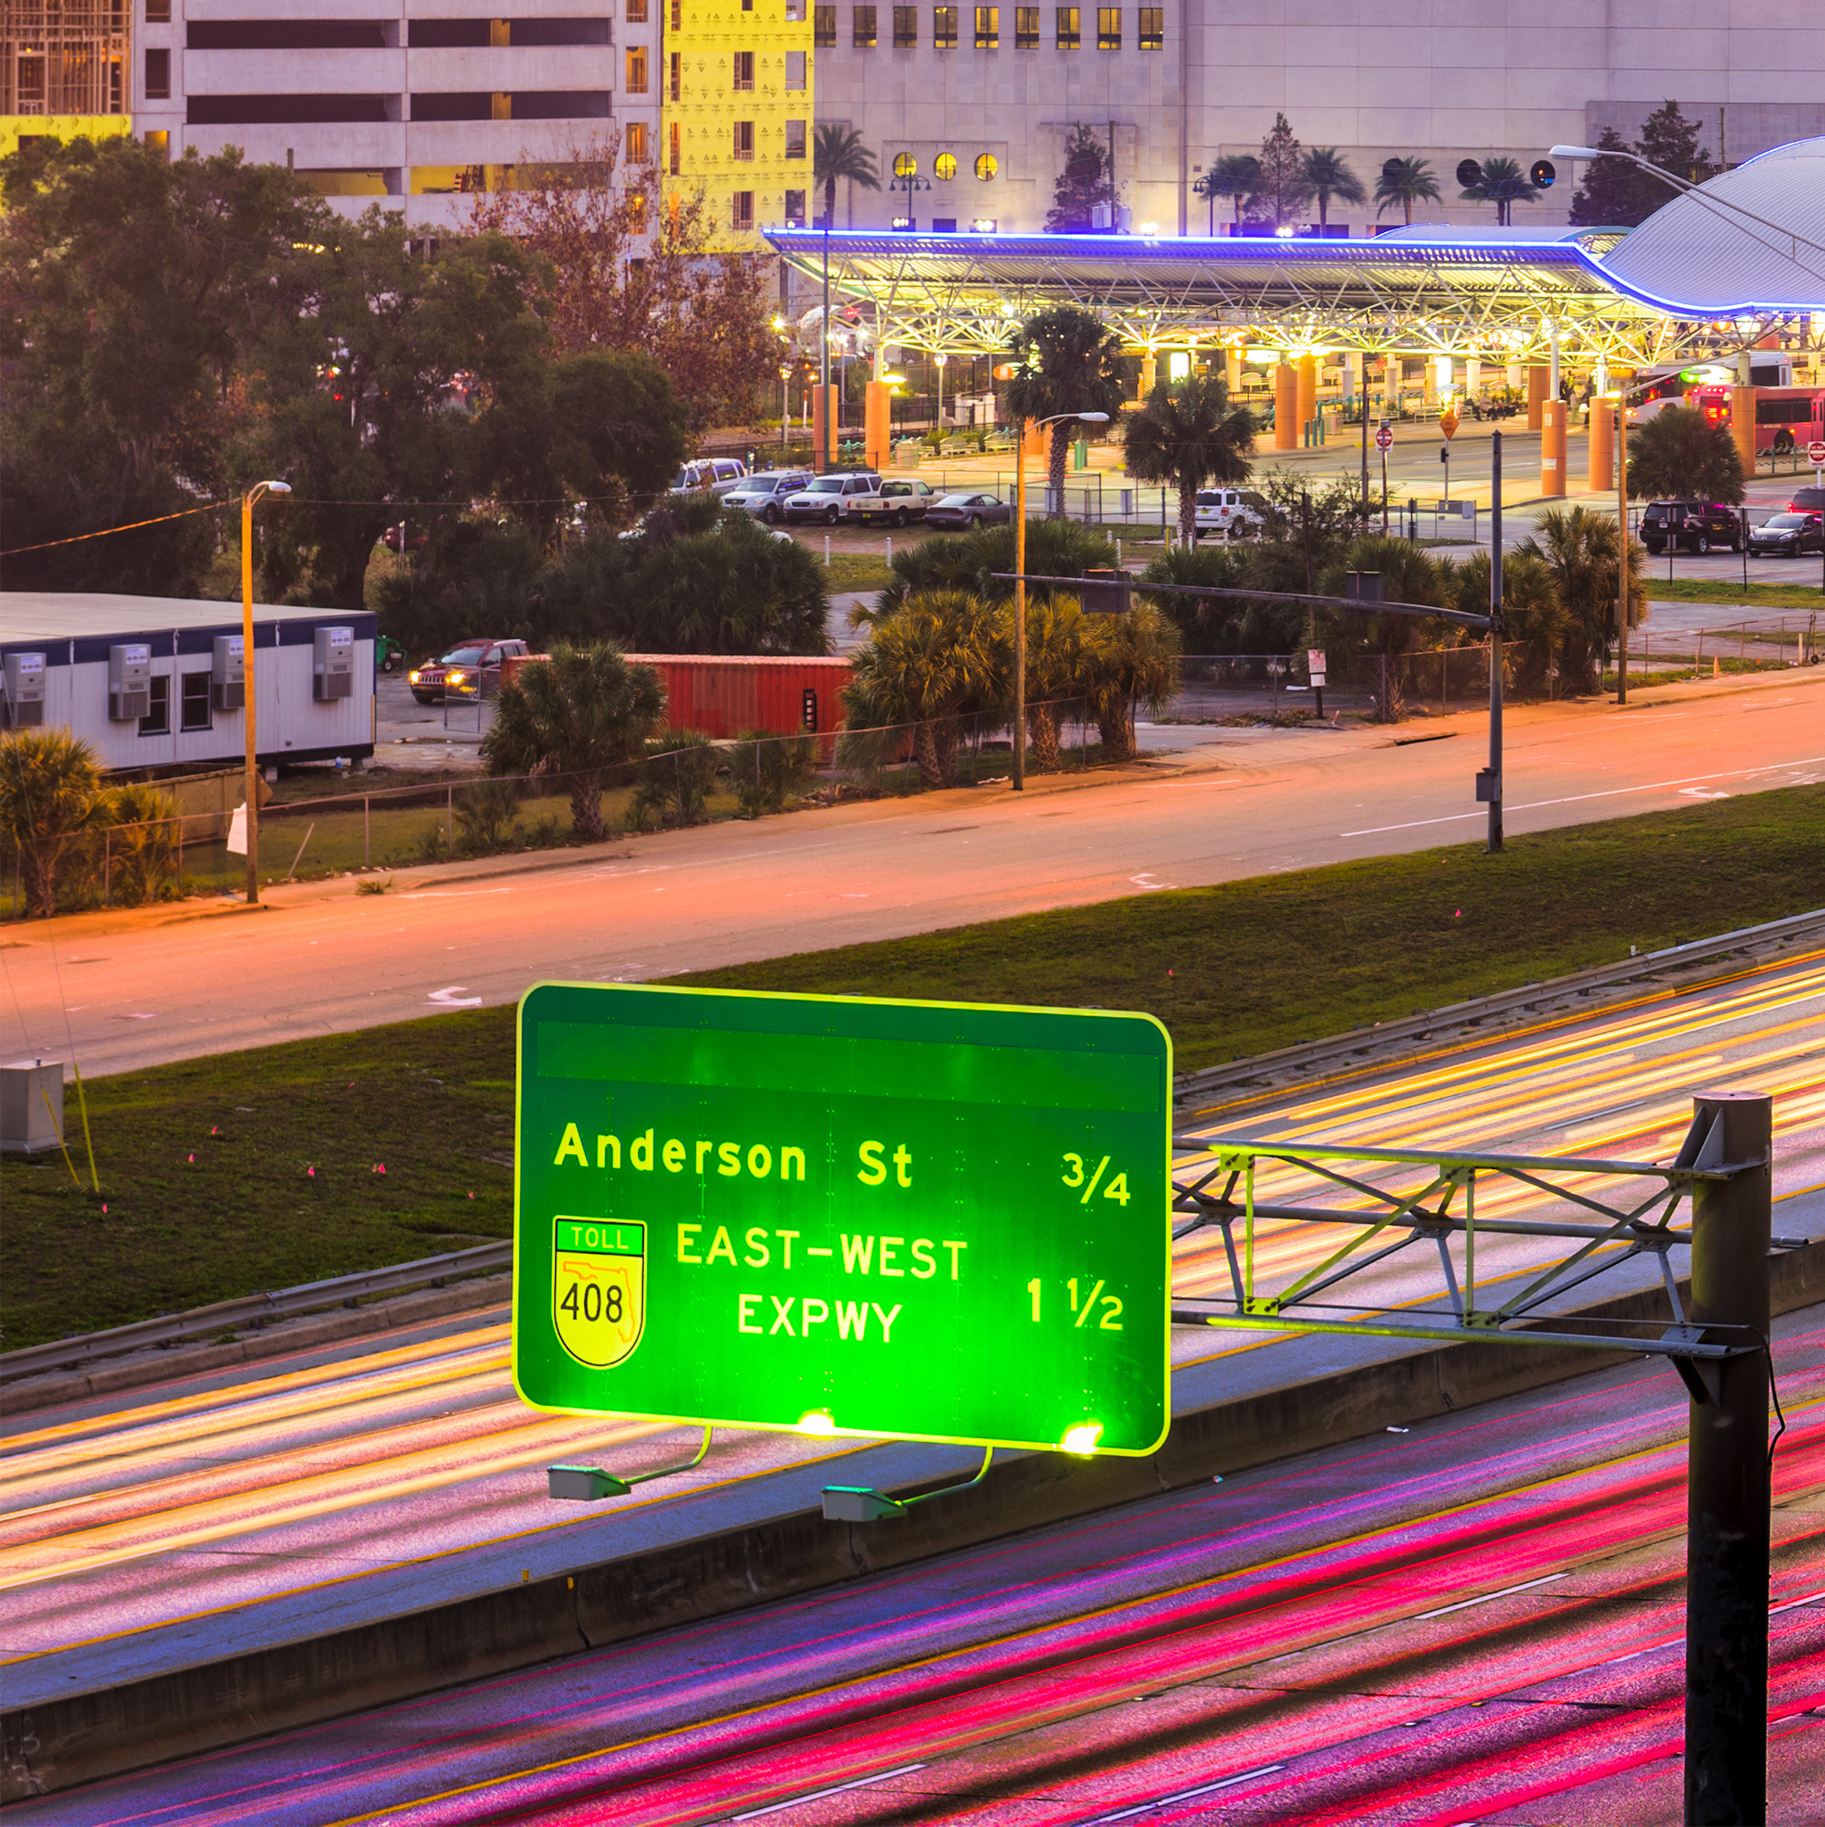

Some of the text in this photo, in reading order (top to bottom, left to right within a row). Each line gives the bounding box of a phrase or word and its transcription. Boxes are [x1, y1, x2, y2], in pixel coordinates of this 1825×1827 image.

[555, 1123, 805, 1180] Anderson
[858, 1141, 911, 1187] St
[571, 1227, 629, 1249] TOLL
[678, 1224, 967, 1280] EAST-WEST
[561, 1283, 622, 1323] 408
[739, 1294, 902, 1343] EXPWY
[1028, 1278, 1040, 1322] 1
